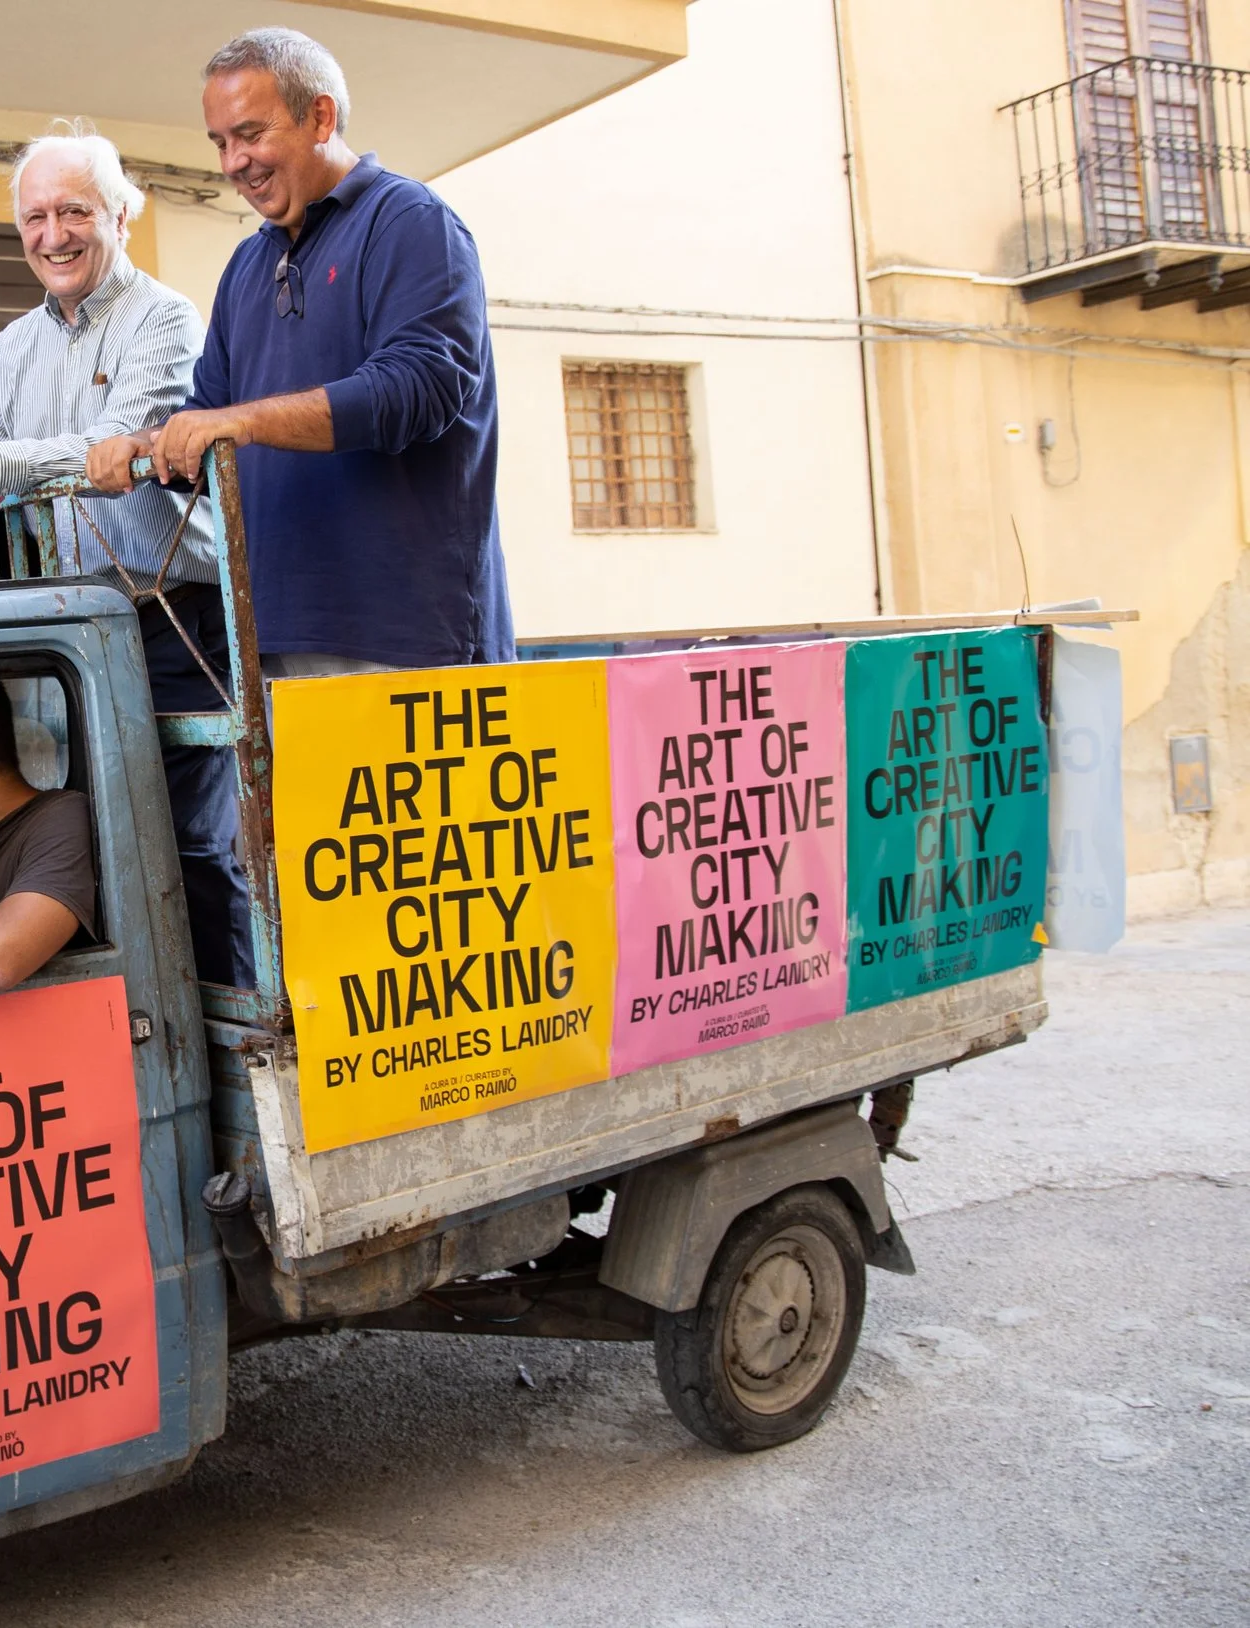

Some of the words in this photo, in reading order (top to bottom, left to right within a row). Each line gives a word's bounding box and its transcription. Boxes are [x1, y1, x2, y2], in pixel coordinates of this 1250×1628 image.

[690, 666, 775, 726] THE
[914, 646, 985, 700] THE
[390, 686, 511, 753] THE
[887, 704, 956, 761] ART
[968, 696, 1018, 747] OF
[339, 756, 464, 829] ART
[490, 748, 557, 812] OF
[658, 729, 742, 793] ART
[760, 722, 808, 778] OF
[865, 746, 1039, 819] CREATIVE
[635, 776, 834, 859] CREATIVE
[916, 805, 995, 865] CITY
[304, 809, 594, 901] CREATIVE
[690, 841, 790, 909] CITY
[878, 851, 1022, 927] MAKING
[387, 883, 531, 958] CITY
[655, 892, 819, 980] MAKING
[860, 939, 889, 967] BY
[893, 922, 968, 957] CHARLES
[971, 905, 1033, 941] LANDRY
[340, 941, 574, 1037] MAKING
[630, 995, 662, 1023] BY
[669, 970, 758, 1015] CHARLES
[763, 952, 831, 992] LANDRY
[326, 1055, 362, 1088] BY
[372, 1028, 491, 1077] CHARLES
[502, 1006, 594, 1052] LANDRY
[698, 1022, 739, 1043] MARCO
[420, 1087, 470, 1111] MARCO
[475, 1074, 516, 1099] RAINÒ
[425, 1084, 429, 1092] A
[431, 1079, 449, 1090] CURA
[451, 1077, 457, 1085] DI
[466, 1069, 501, 1082] CURATED
[503, 1067, 512, 1075] BY
[3, 1357, 131, 1417] LANDRY
[5, 1431, 16, 1440] BY
